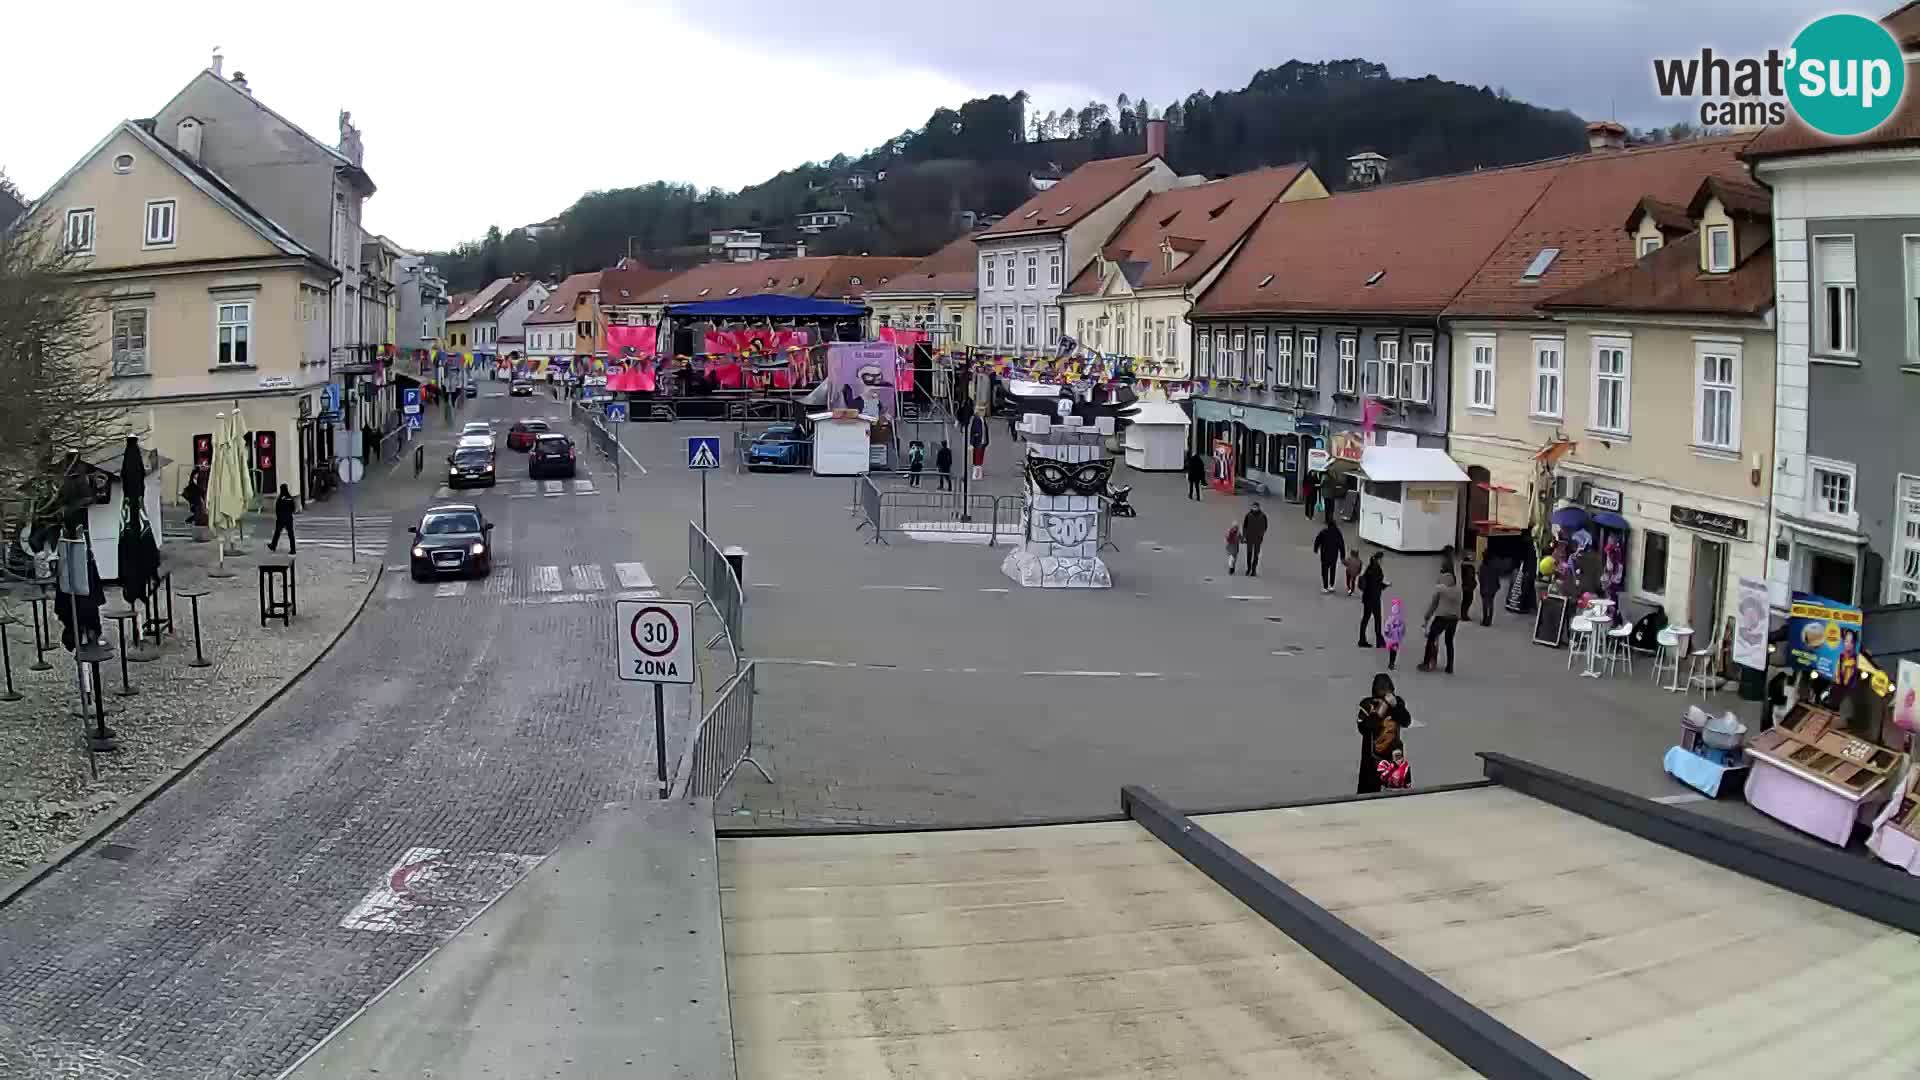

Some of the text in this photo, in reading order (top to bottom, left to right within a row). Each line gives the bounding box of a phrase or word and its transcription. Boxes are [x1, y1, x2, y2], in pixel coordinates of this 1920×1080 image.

[407, 391, 416, 402] P
[1048, 516, 1088, 545] 200
[643, 622, 667, 643] 30
[633, 659, 678, 677] ZONA
